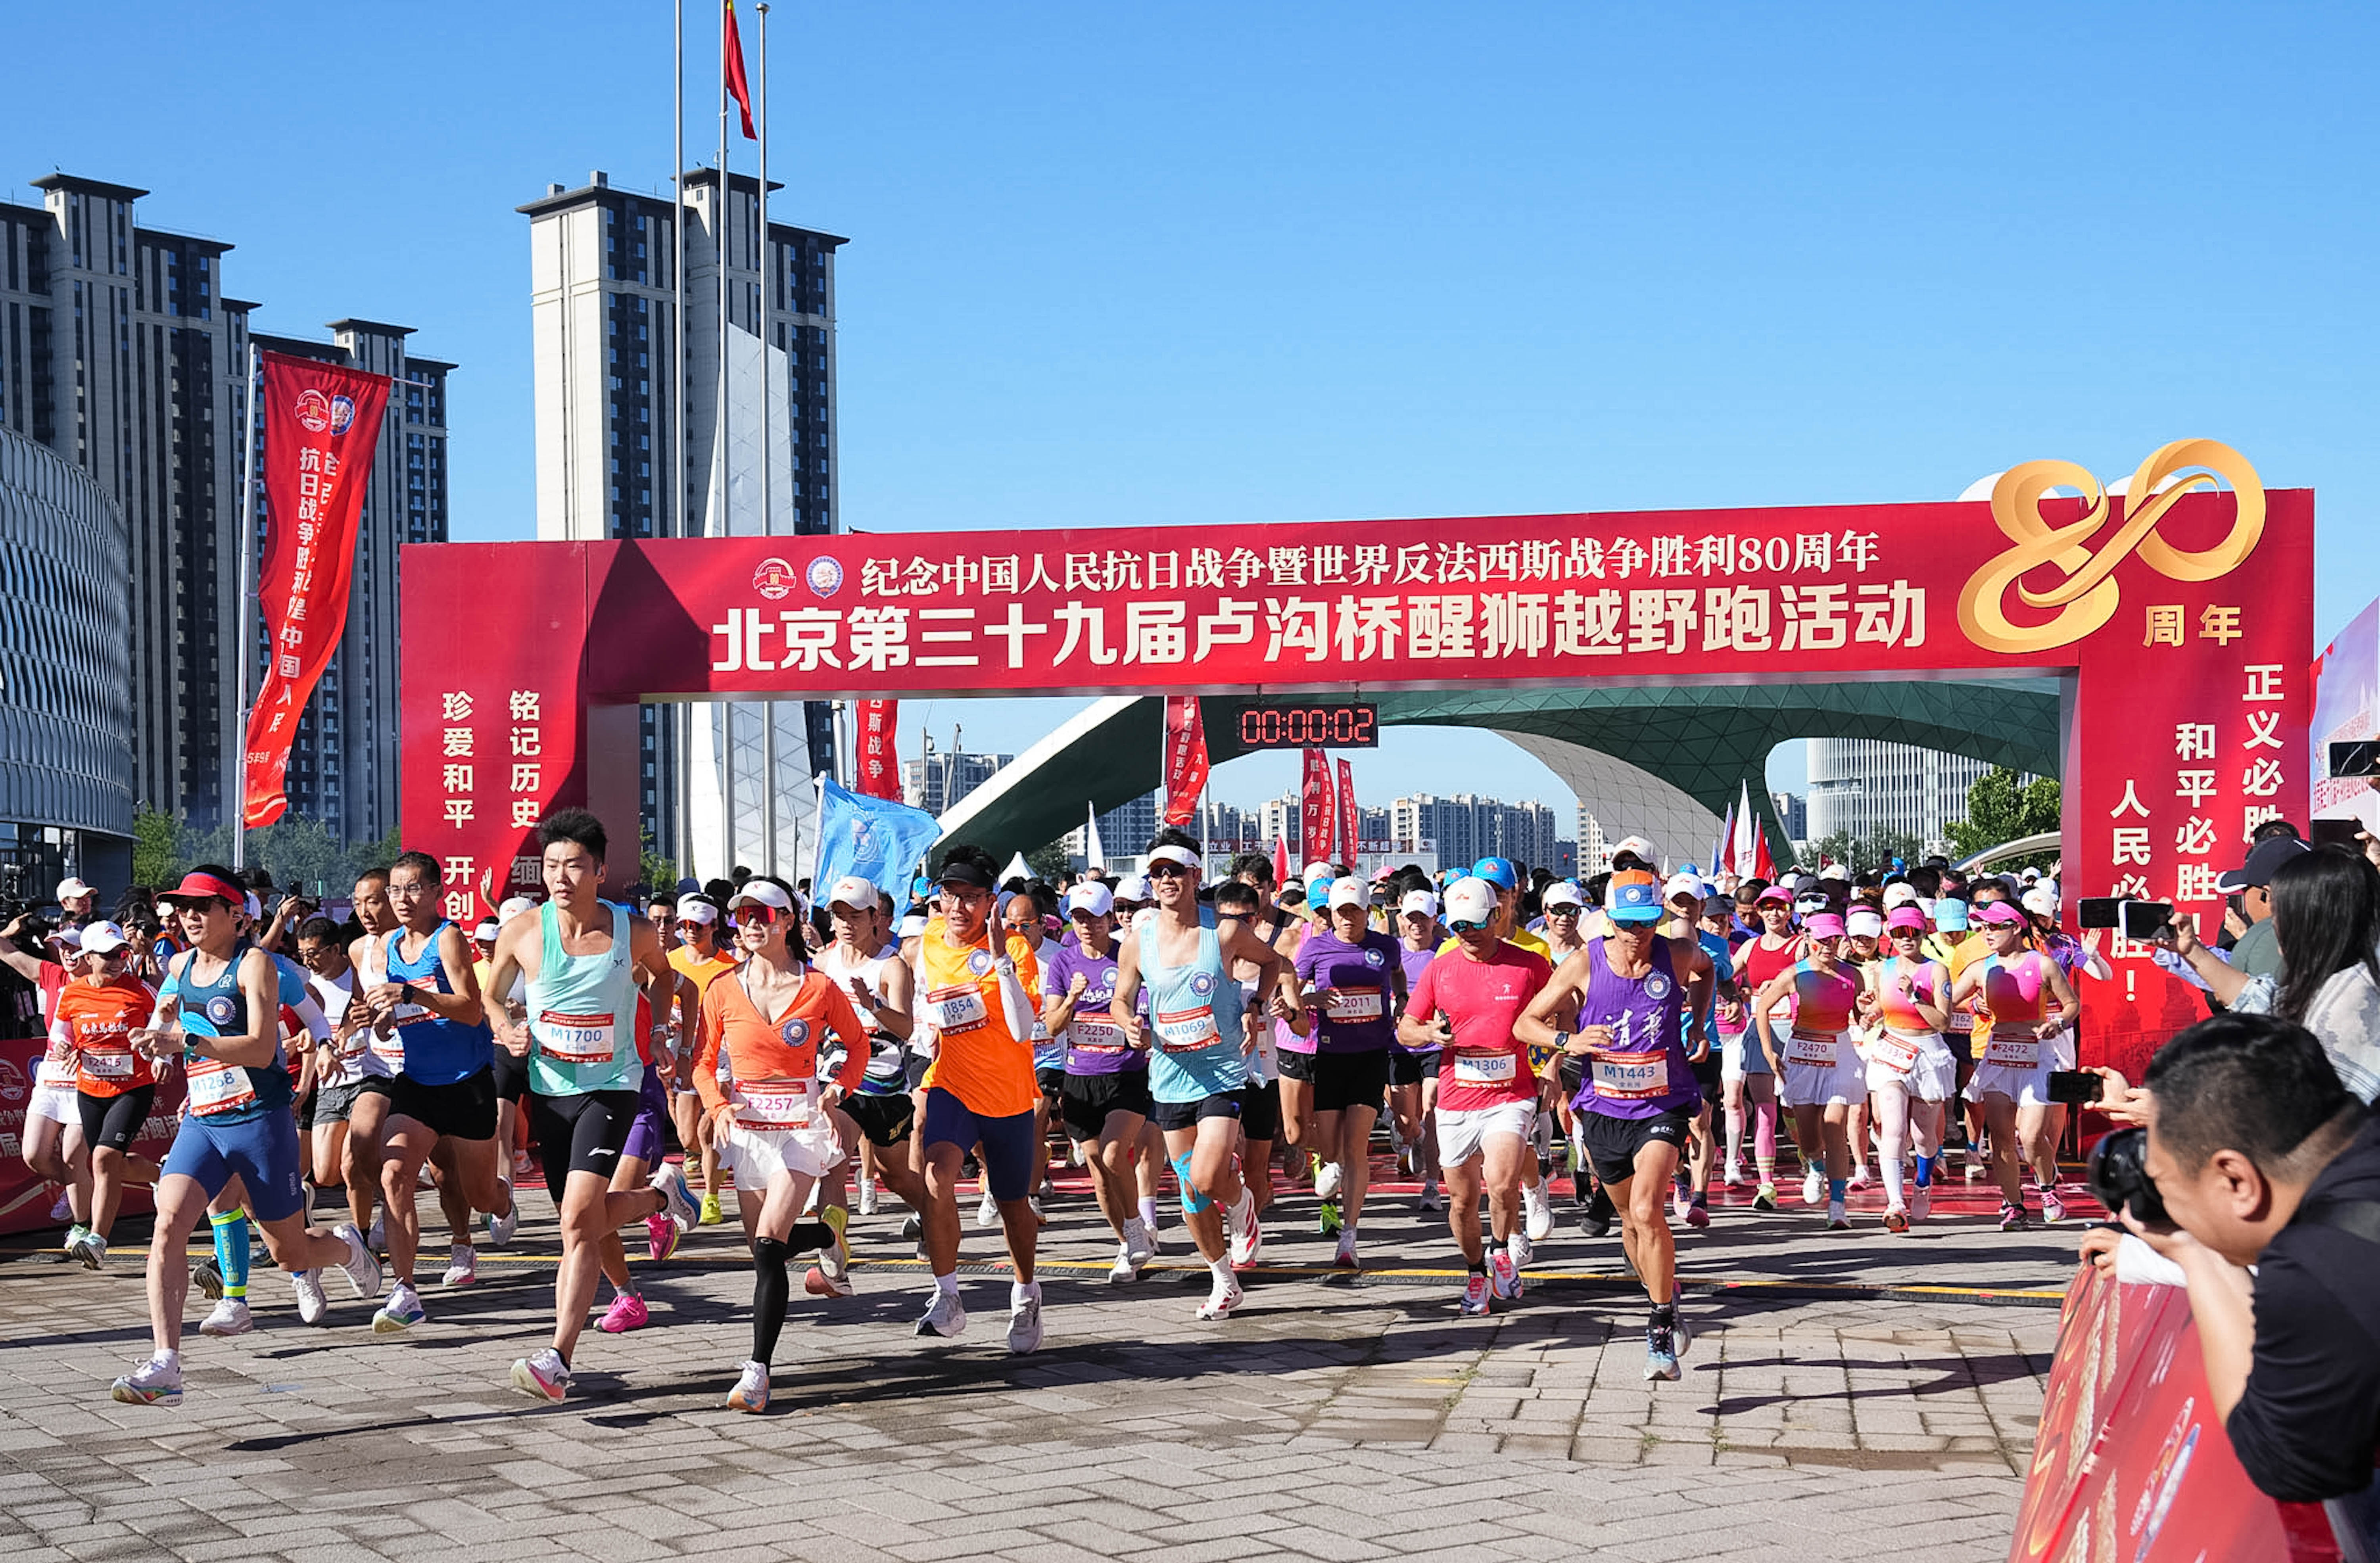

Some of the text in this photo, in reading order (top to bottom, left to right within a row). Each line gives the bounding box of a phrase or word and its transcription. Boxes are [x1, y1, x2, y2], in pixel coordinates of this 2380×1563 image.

[861, 529, 1880, 597] 纪念中国人民抗日战争暨世界反法西斯战争胜利80周年
[713, 580, 1927, 672] 北京第三十九届卢沟桥醒狮越野跑活动
[2143, 604, 2243, 647] 周年
[1242, 709, 1373, 743] 00:00:02
[509, 690, 541, 828] 铭记历史
[442, 691, 475, 943] 珍爱和平 开创
[551, 1027, 602, 1042] M1700
[1078, 1025, 1113, 1036] F2250
[1165, 1020, 1205, 1036] M1069
[1797, 1042, 1827, 1052] F2470
[1463, 1059, 1506, 1071] M1306
[1605, 1065, 1655, 1079] M1443
[192, 1072, 234, 1092] M1268
[748, 1097, 793, 1110] F2257
